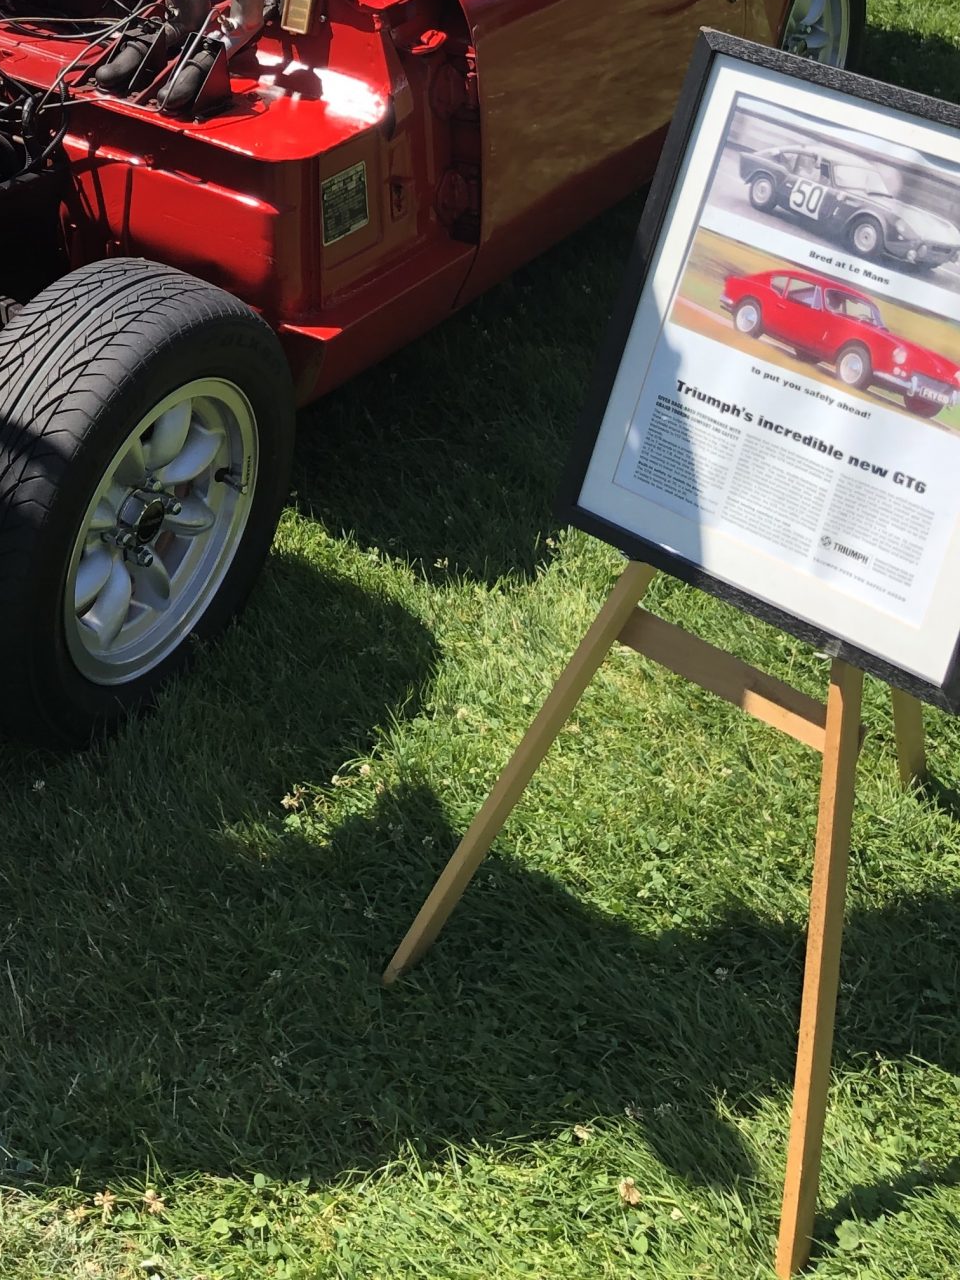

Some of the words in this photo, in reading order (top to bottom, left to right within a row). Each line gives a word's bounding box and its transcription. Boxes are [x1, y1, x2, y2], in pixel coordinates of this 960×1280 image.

[792, 180, 823, 214] 50
[809, 250, 833, 265] Bred
[835, 260, 846, 269] at
[848, 264, 861, 273] Le
[862, 269, 890, 285] Mans
[751, 366, 761, 375] to
[763, 372, 780, 383] put
[783, 379, 801, 391] you
[804, 387, 835, 406] safely
[837, 401, 871, 420] ahead!
[676, 379, 754, 422] Triumph's
[757, 415, 844, 461] incredible
[848, 455, 889, 478] new
[892, 471, 927, 494] GT6
[833, 542, 870, 566] TRIUMPH
